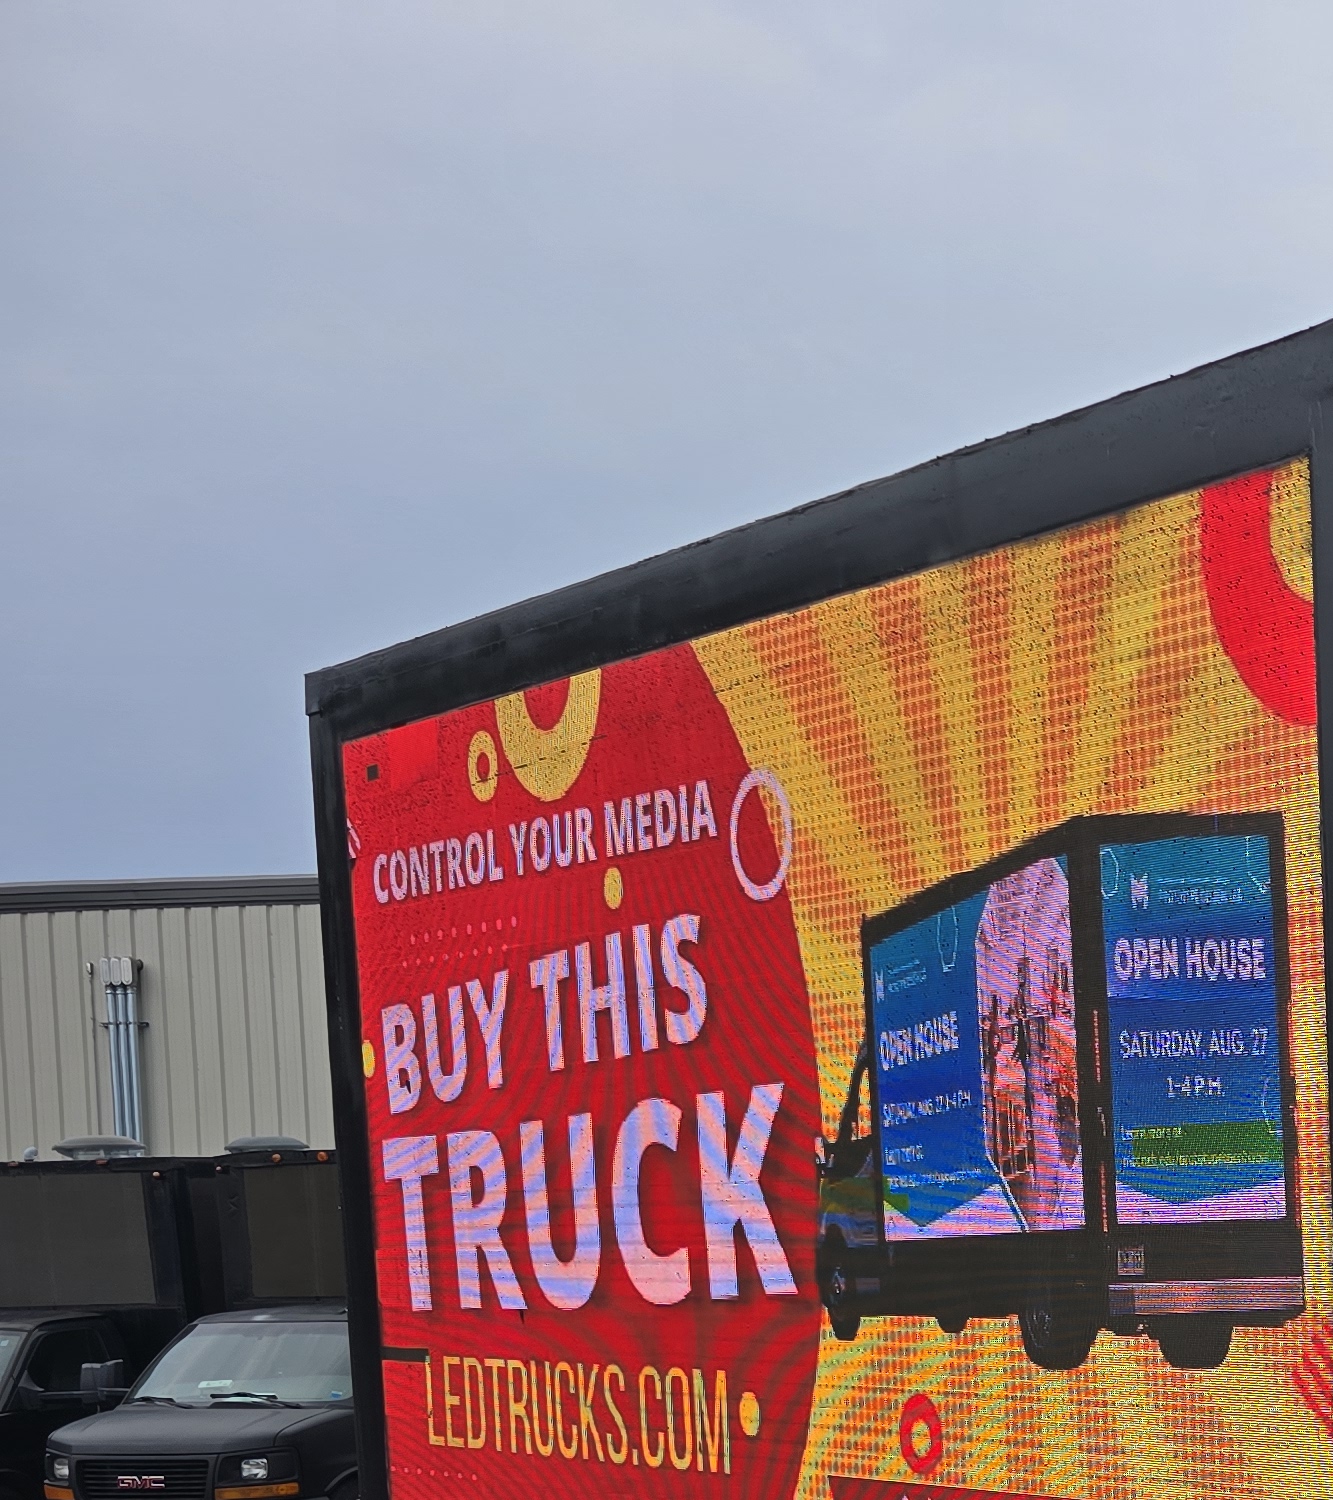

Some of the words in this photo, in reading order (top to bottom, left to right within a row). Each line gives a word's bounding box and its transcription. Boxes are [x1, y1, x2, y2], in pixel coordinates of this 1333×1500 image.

[373, 829, 503, 904] CONTROL
[509, 807, 597, 876] YOUR
[603, 780, 718, 857] MEDIA
[1113, 937, 1179, 982] OPEN
[1185, 937, 1266, 982] HOUSE
[381, 969, 509, 1115] BUY
[529, 913, 708, 1072] THIS
[879, 1027, 914, 1071] OPEN
[913, 1010, 960, 1062] HOUSE
[1119, 1028, 1207, 1059] SATURDAY,
[1208, 1028, 1248, 1058] AUG.
[1250, 1027, 1269, 1056] 27
[382, 1082, 799, 1312] TRUCK
[425, 1355, 731, 1475] LEDTRUCKS.COM
[117, 1475, 166, 1489] GMC
